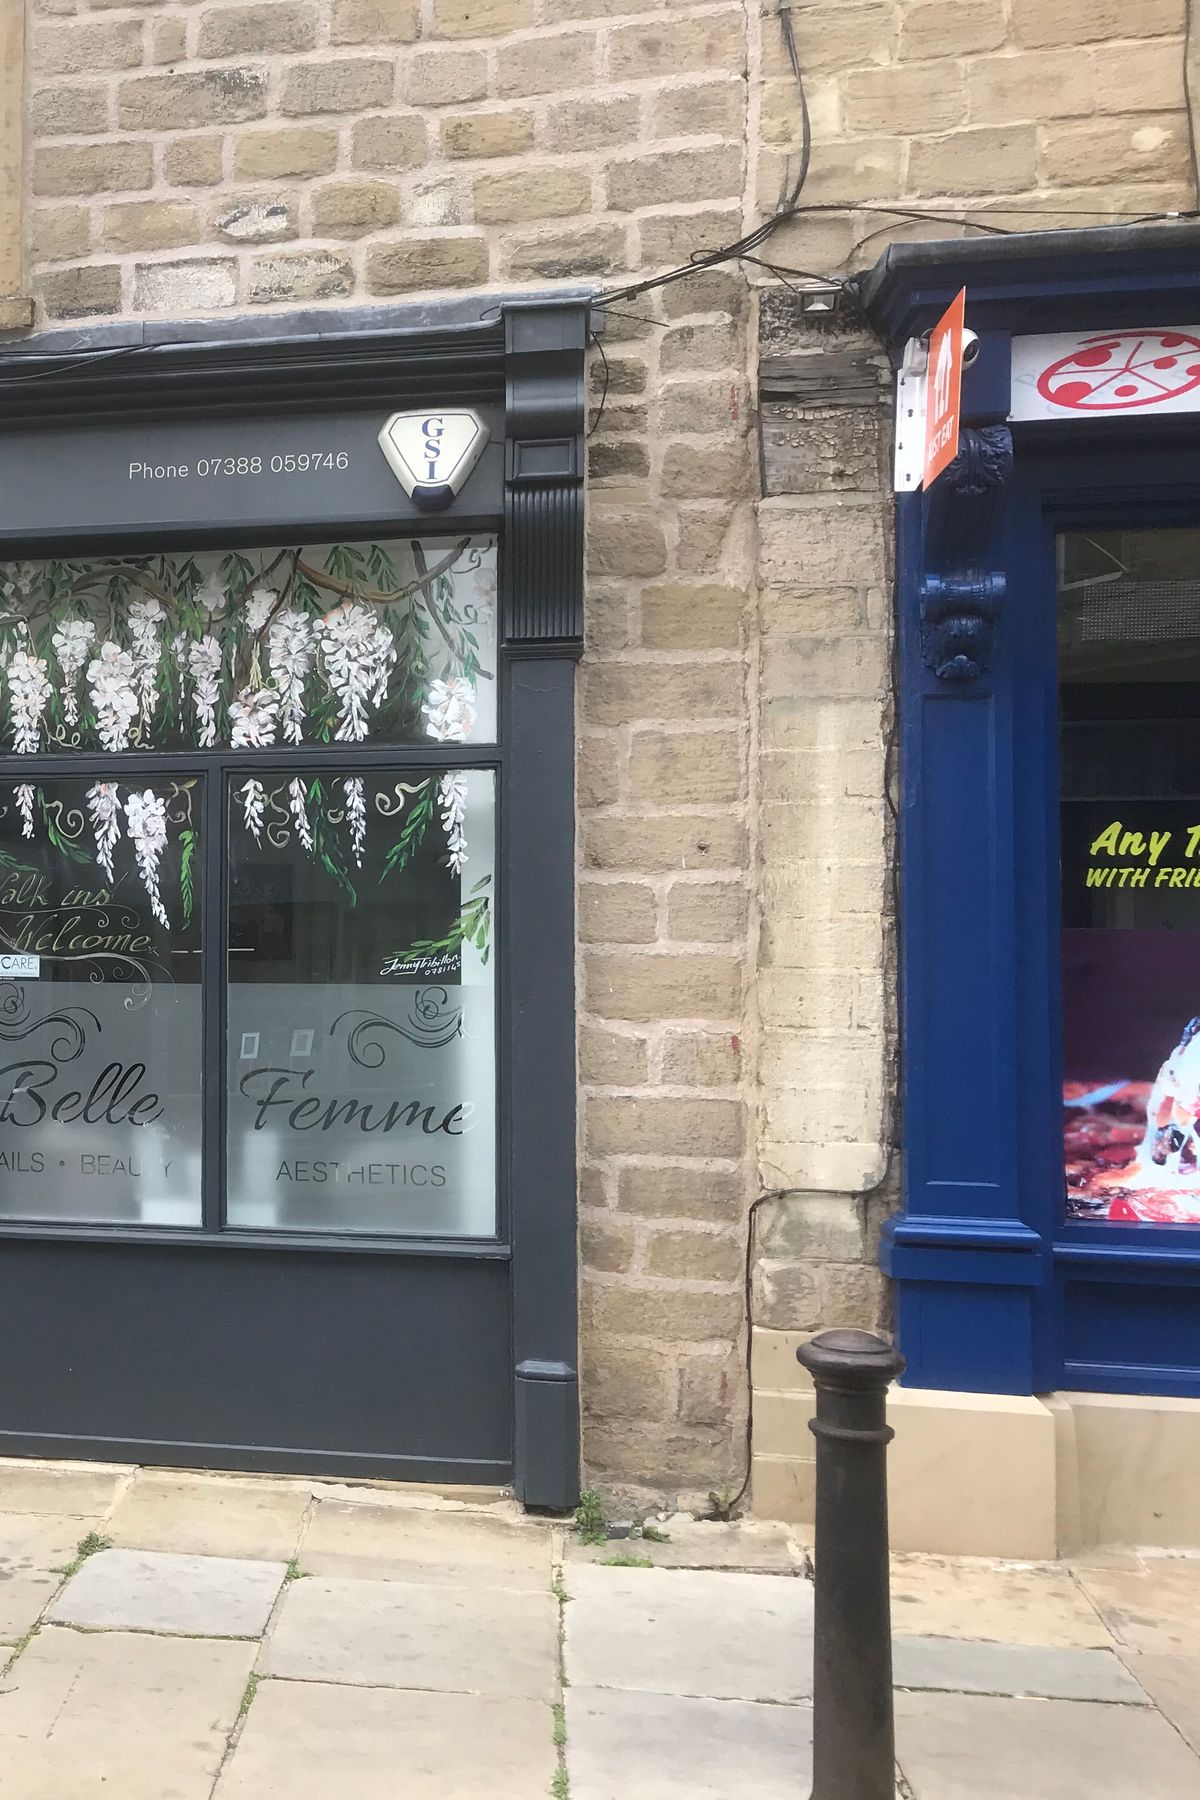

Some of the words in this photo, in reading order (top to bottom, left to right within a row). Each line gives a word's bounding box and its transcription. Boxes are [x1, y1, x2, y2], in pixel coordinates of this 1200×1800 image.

[129, 462, 189, 479] Phone
[197, 456, 262, 477] 07388
[270, 451, 349, 473] 059746
[421, 417, 444, 480] GSI
[1089, 821, 1172, 866] Any
[1085, 867, 1151, 888] WITH
[11, 914, 152, 952] Welcome
[239, 1067, 476, 1136] Femme
[81, 1154, 173, 1178] BEAUY
[275, 1160, 447, 1187] AESTHETICS
